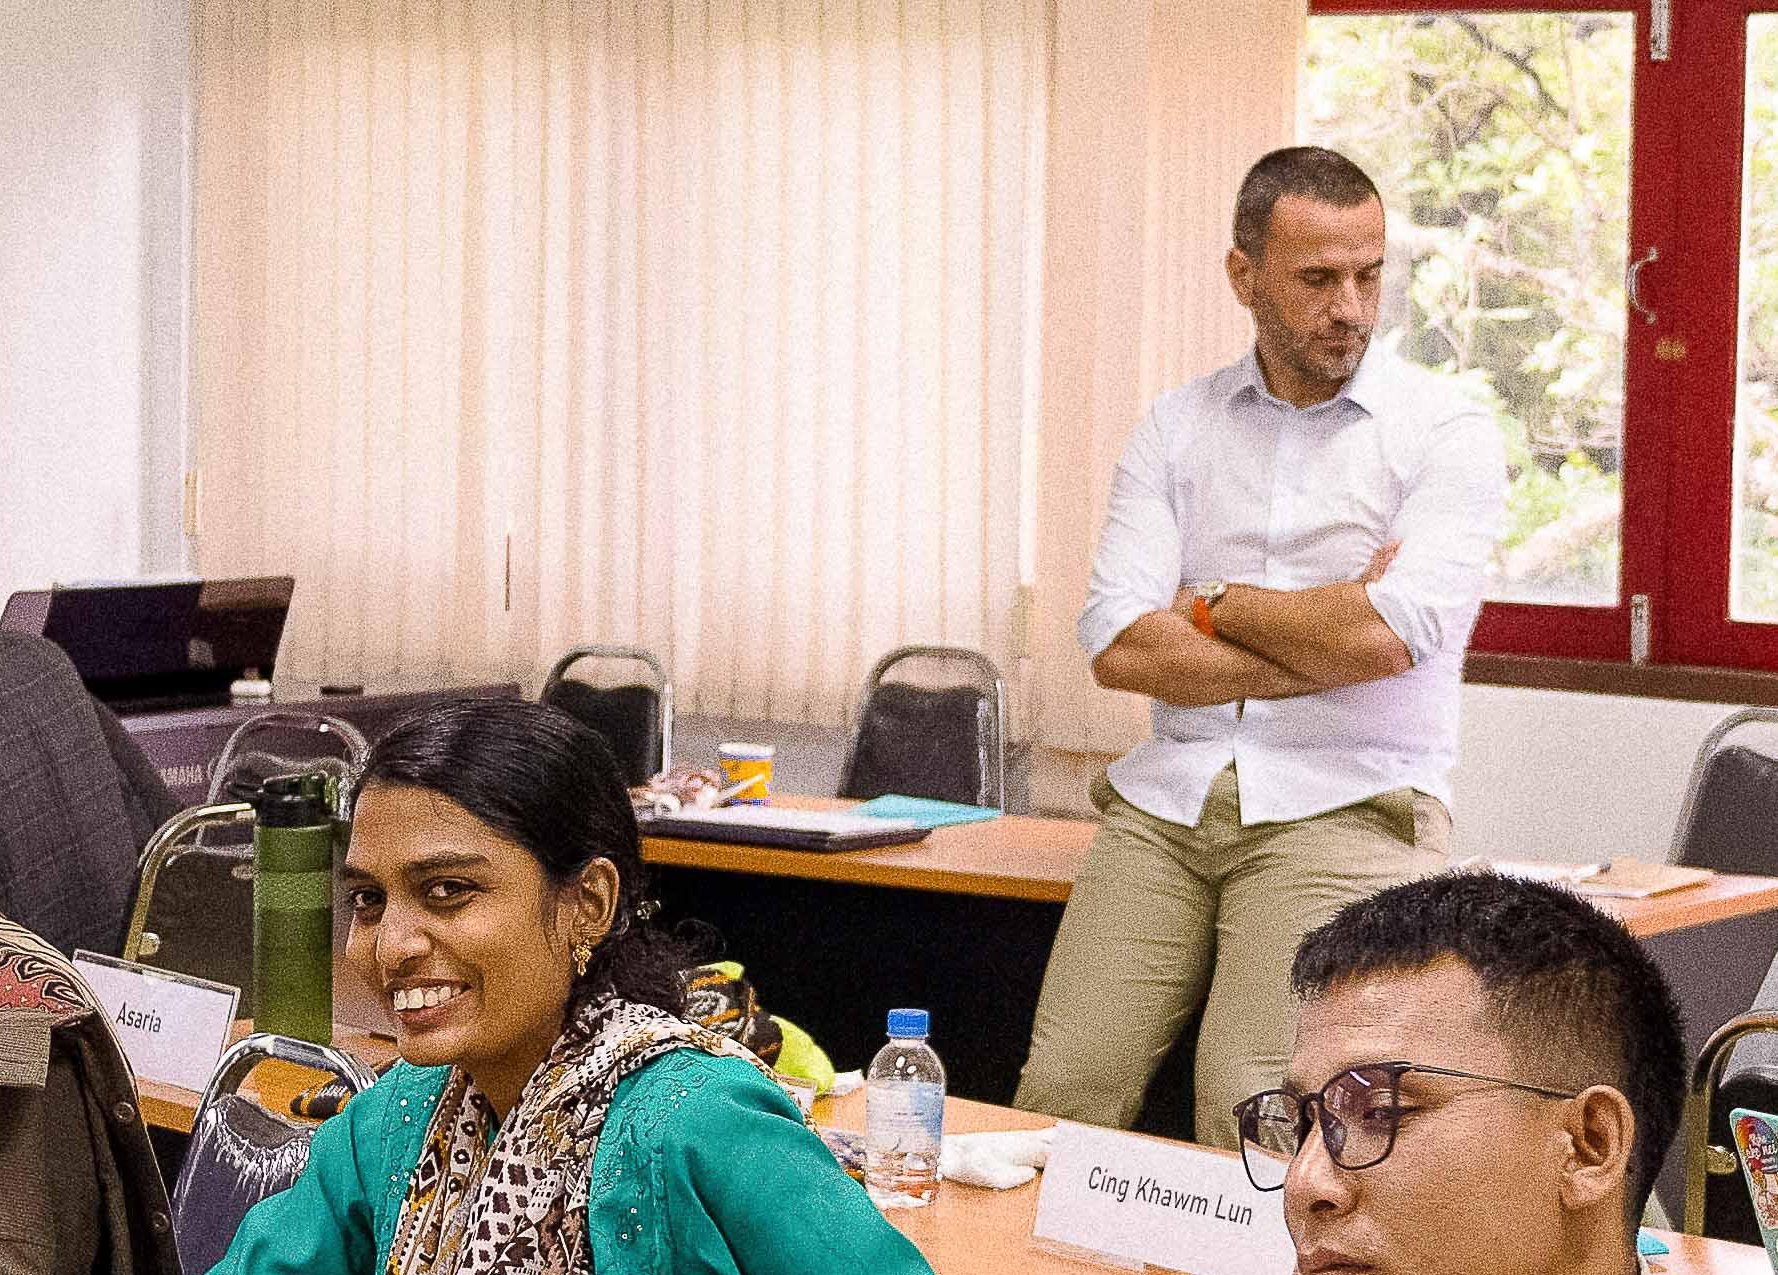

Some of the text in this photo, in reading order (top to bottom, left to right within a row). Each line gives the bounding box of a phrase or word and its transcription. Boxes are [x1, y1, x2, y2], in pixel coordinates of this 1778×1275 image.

[117, 1002, 162, 1034] Asaria
[1088, 1166, 1253, 1225] Cing Khawm Lun
